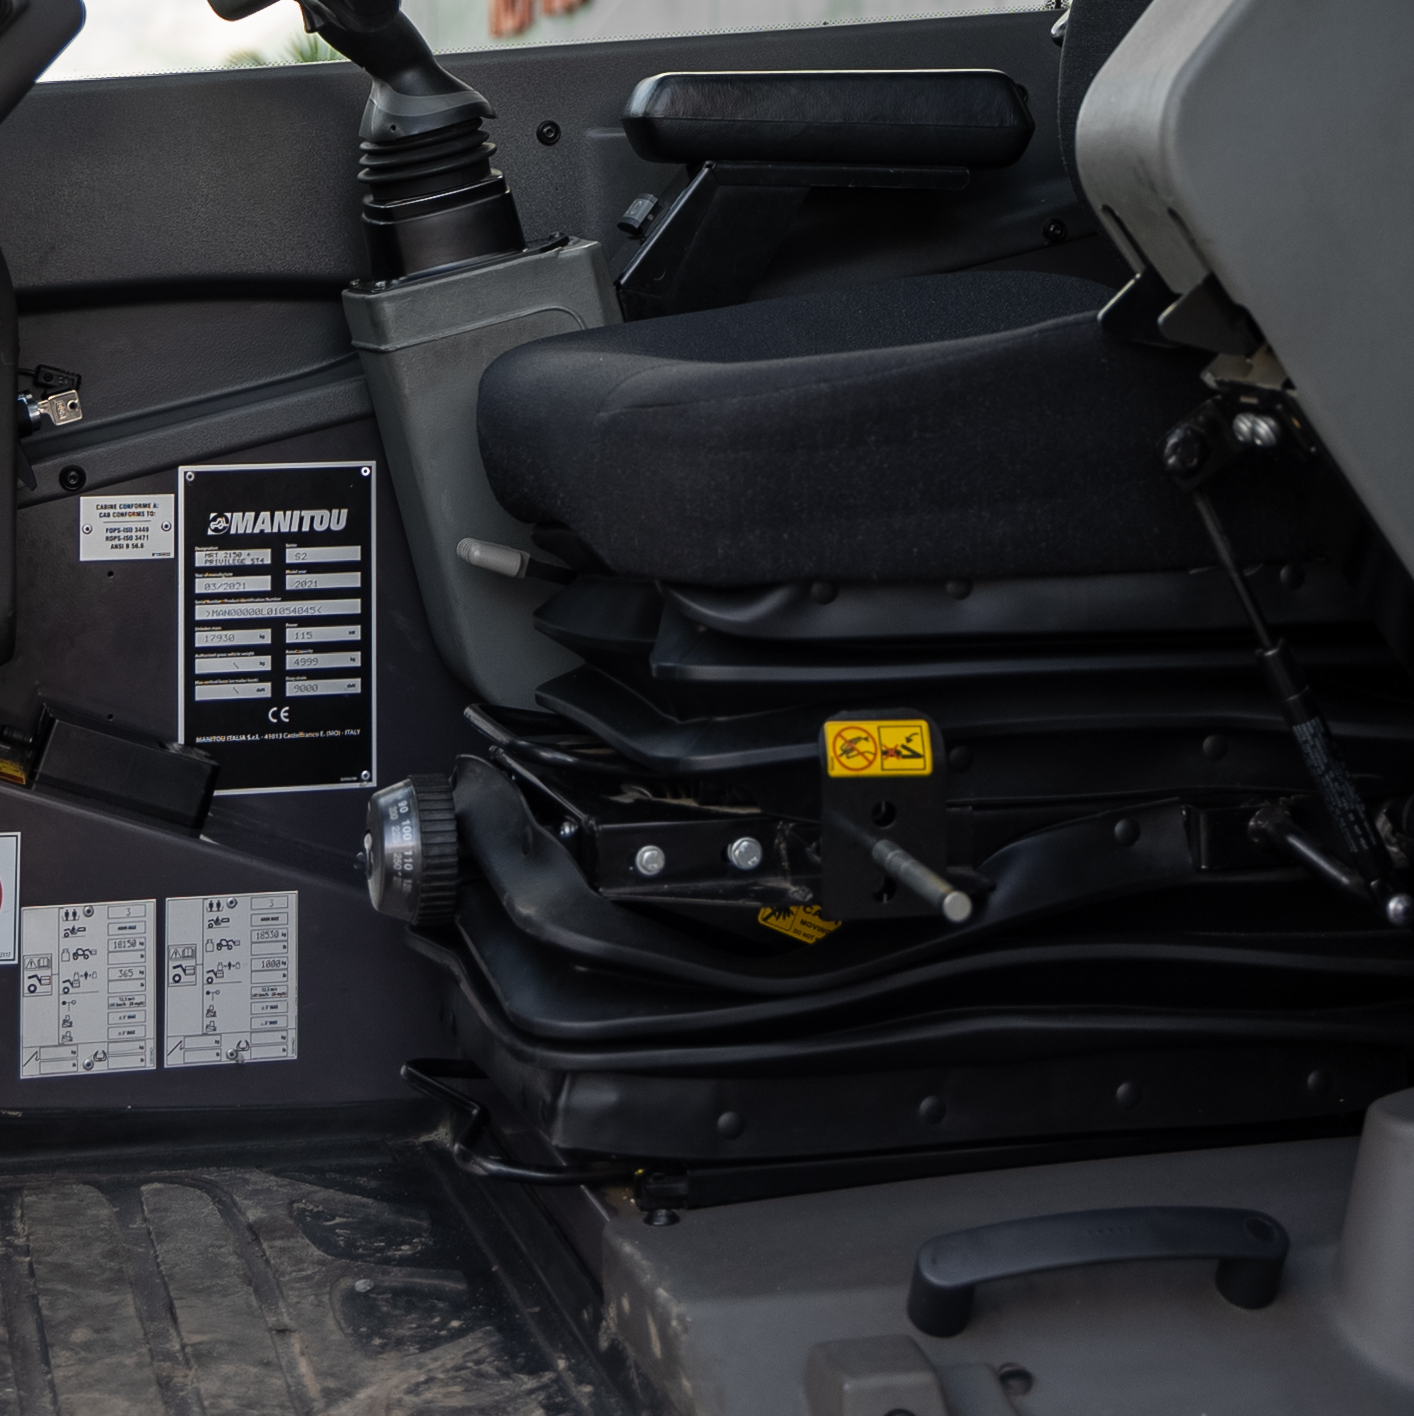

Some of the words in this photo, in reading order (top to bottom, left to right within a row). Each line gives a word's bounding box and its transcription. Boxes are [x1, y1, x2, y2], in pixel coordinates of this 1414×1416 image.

[229, 508, 349, 535] MANITOU
[294, 552, 307, 560] S2
[204, 582, 246, 591] 03/2021
[295, 580, 318, 588] 2021
[204, 634, 235, 643] 17930
[295, 631, 312, 640] 115
[294, 658, 319, 666] 4999
[294, 684, 318, 693] 9000
[268, 706, 290, 722] CE
[344, 728, 361, 736] ITALY
[398, 800, 409, 814] 90
[402, 819, 412, 841] 100
[403, 850, 413, 871] 110
[118, 969, 133, 978] 365
